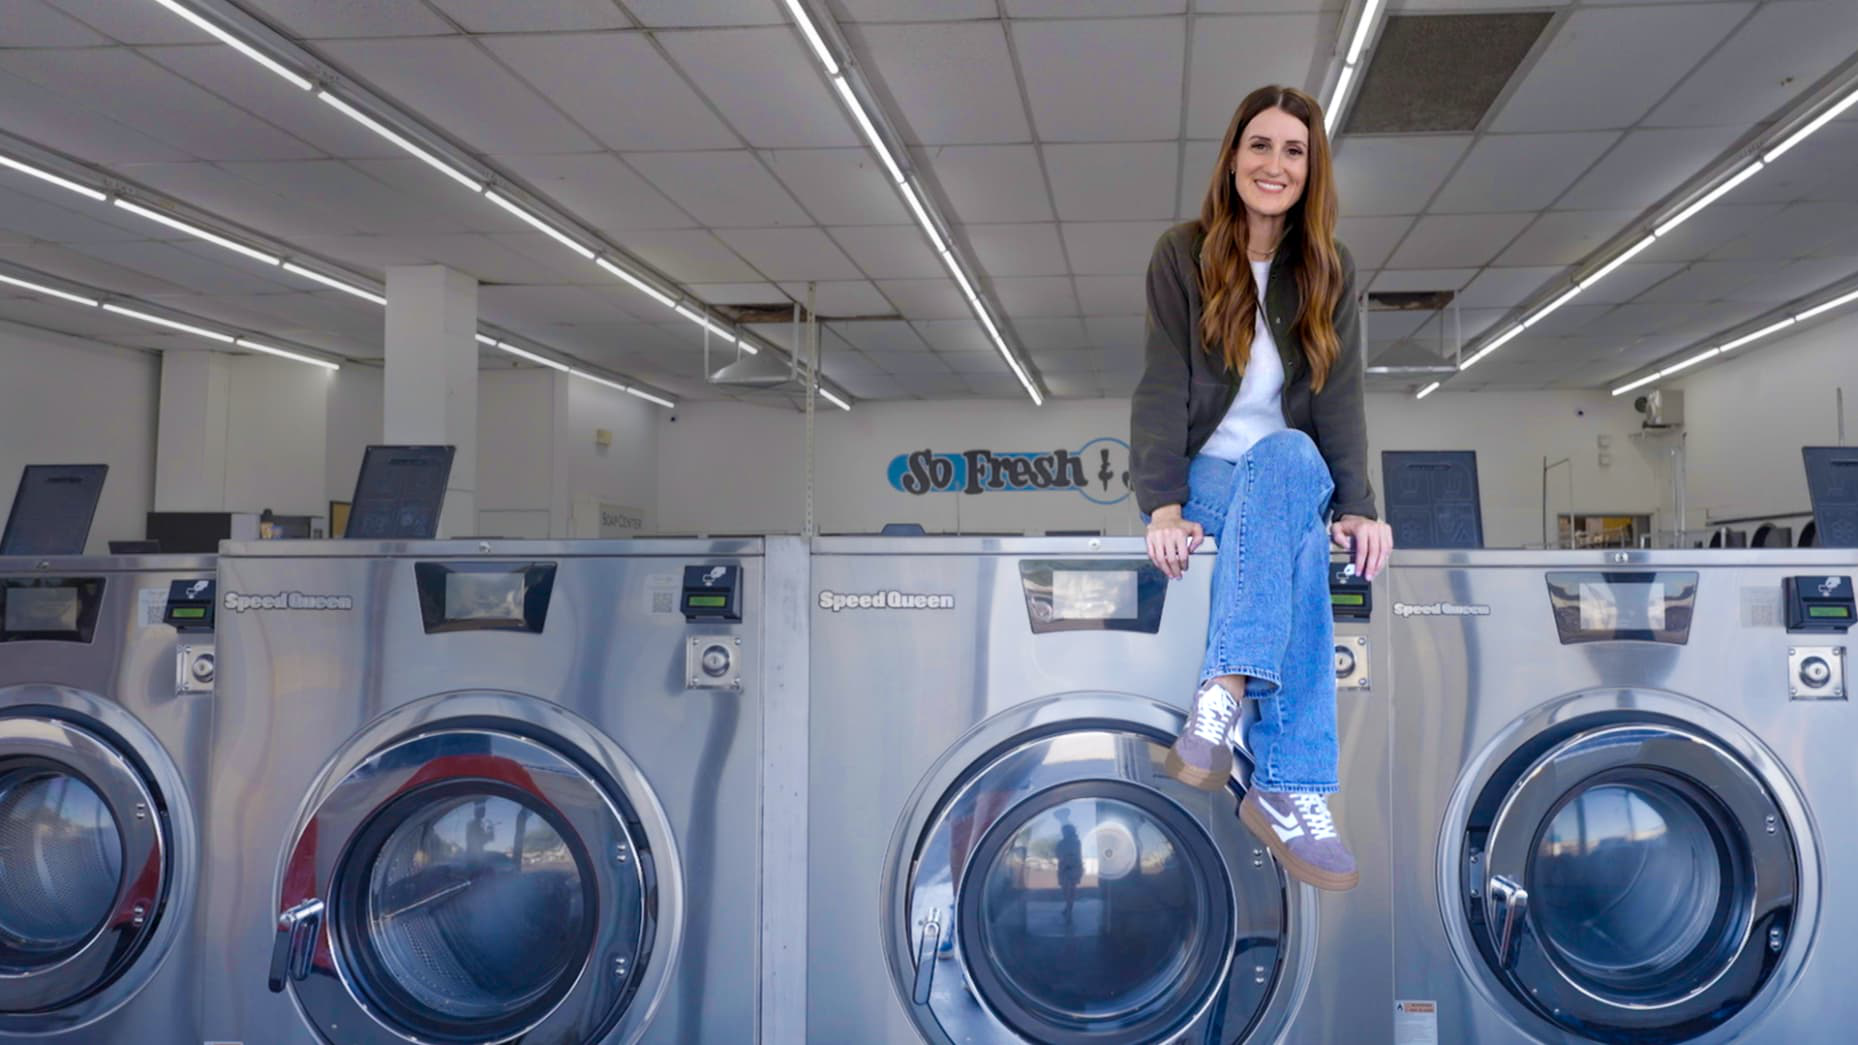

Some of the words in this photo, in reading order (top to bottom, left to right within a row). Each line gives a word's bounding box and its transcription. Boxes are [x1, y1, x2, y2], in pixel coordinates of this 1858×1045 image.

[902, 448, 951, 495] So
[963, 448, 1089, 495] Fresh
[224, 591, 288, 613] Speed
[288, 591, 352, 610] Queen
[818, 590, 887, 612] Speed
[887, 590, 955, 609] Queen
[1393, 602, 1441, 618] Speed
